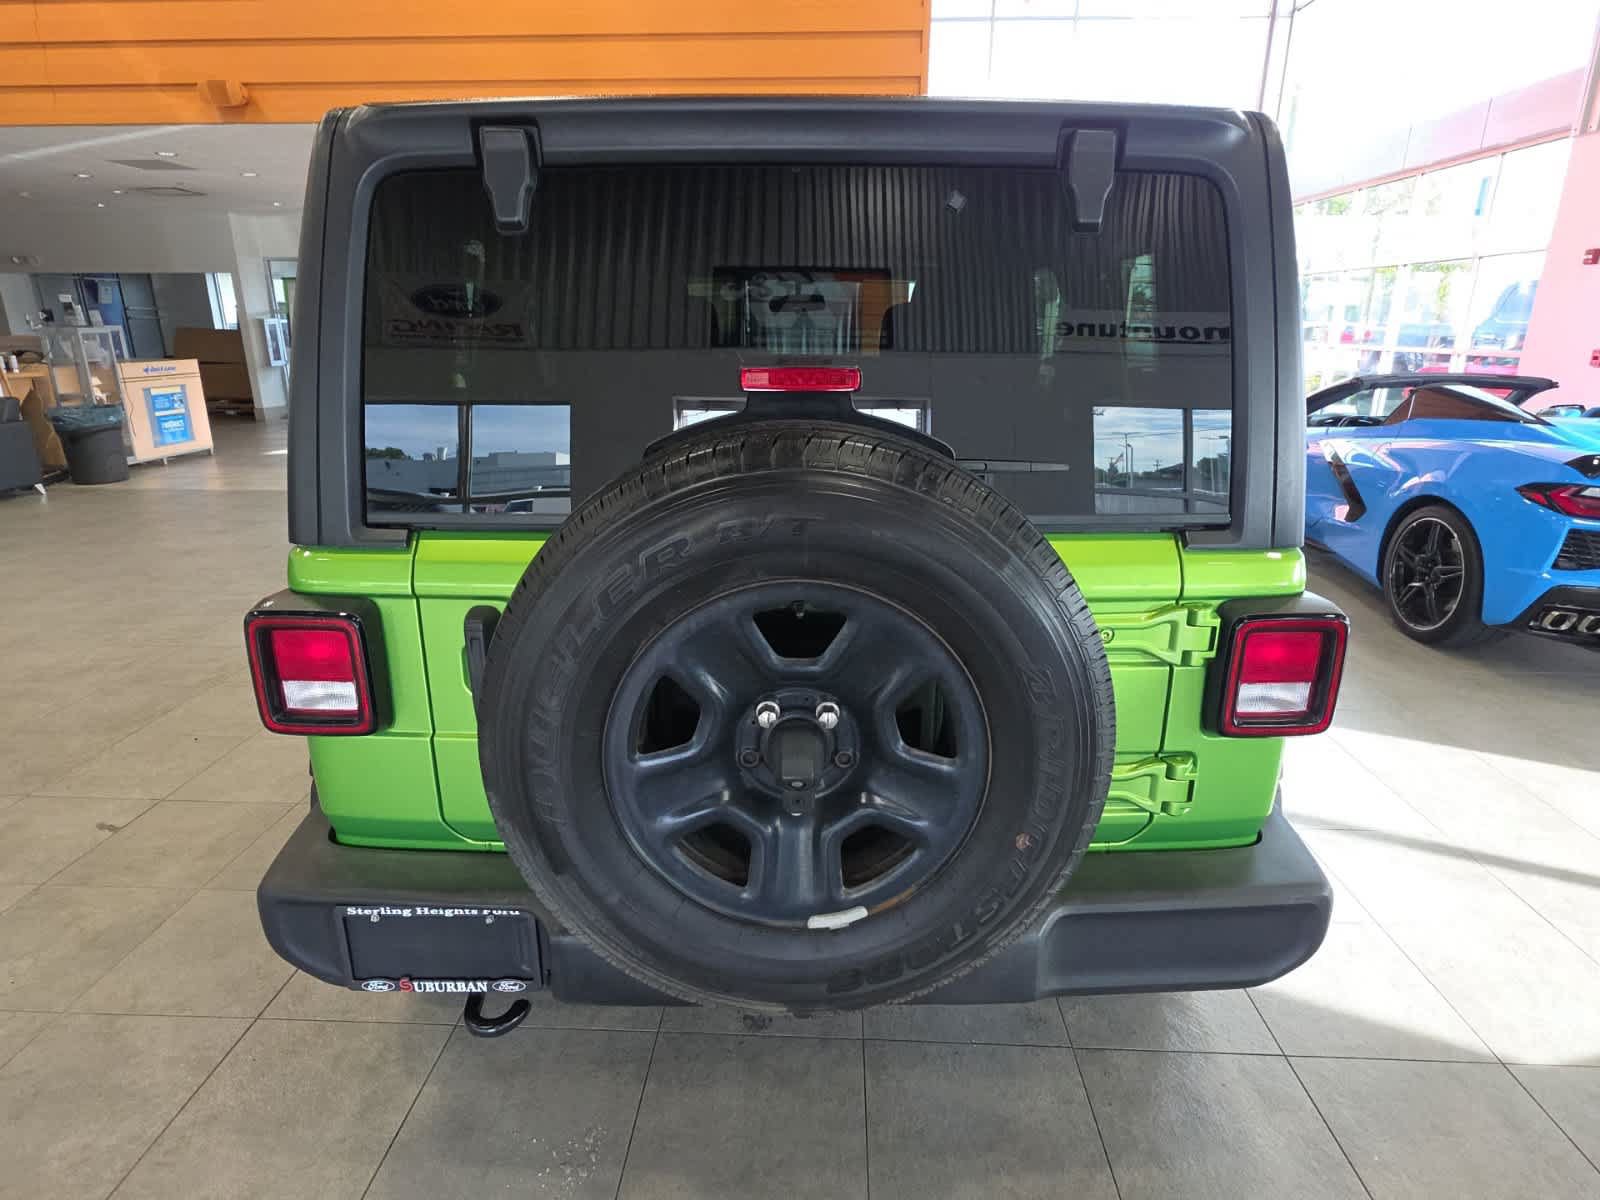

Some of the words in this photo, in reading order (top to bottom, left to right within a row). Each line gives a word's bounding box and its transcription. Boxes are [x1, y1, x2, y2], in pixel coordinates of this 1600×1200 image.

[346, 906, 412, 917] Sterling
[415, 906, 478, 917] Heights
[365, 980, 391, 991] Ford
[400, 977, 488, 992] SUBURBAN
[496, 980, 523, 991] Ford
